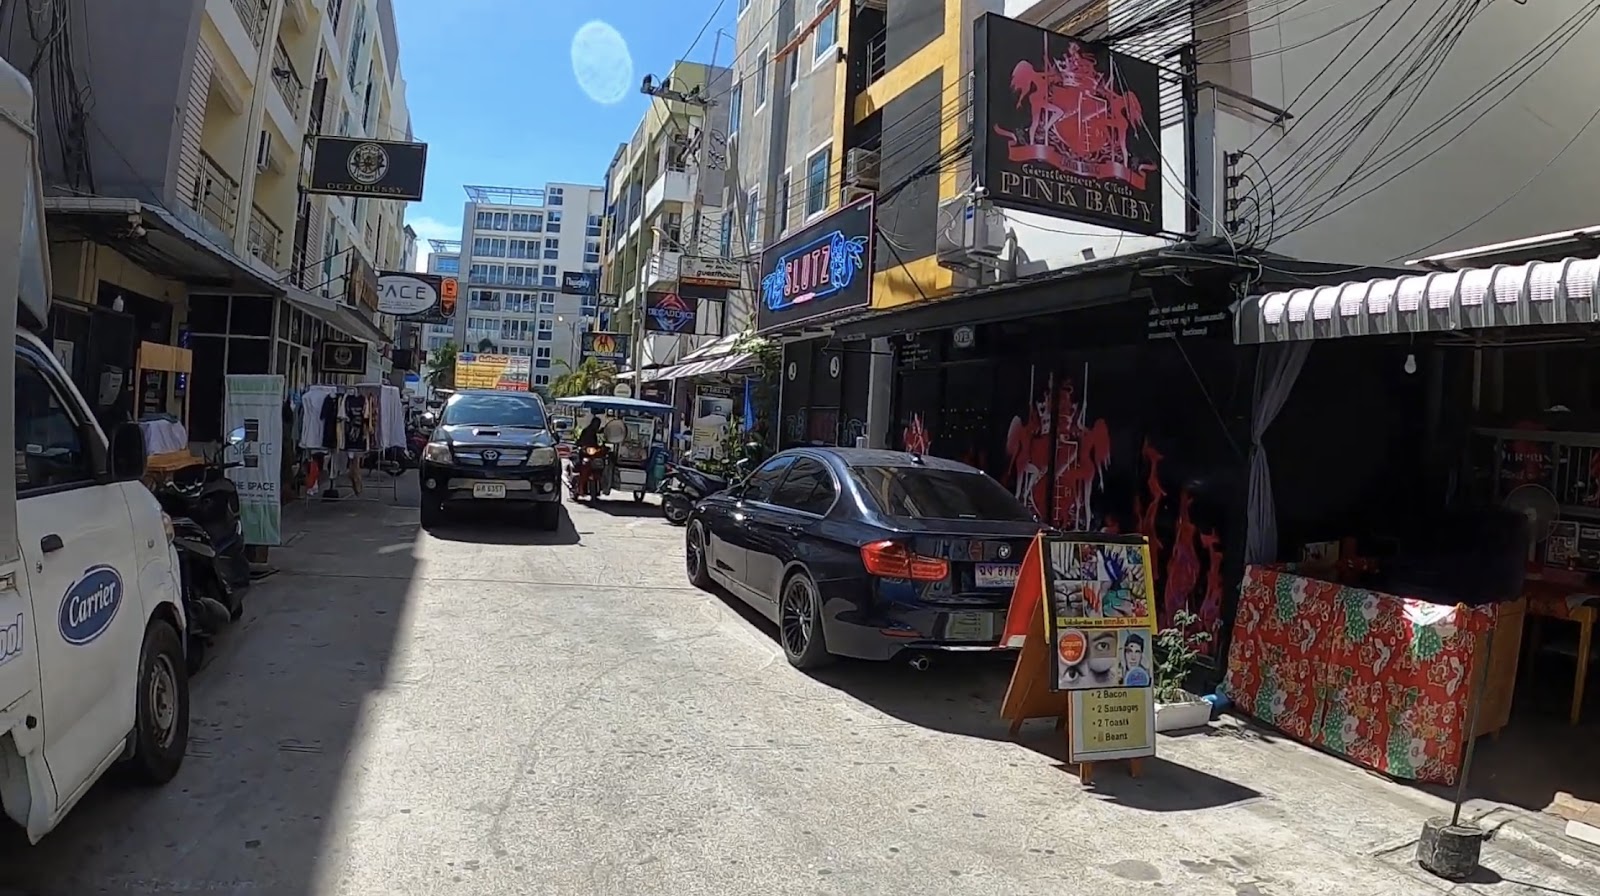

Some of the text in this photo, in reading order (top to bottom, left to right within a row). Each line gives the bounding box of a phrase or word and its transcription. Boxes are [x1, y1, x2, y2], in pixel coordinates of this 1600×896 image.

[1021, 163, 1101, 189] Gentlemen's
[1104, 180, 1133, 197] Club
[326, 182, 404, 194] OCTOPUSSY
[1000, 171, 1154, 223] PINK BABY
[784, 245, 830, 296] SLUTZ
[377, 283, 427, 299] PACE
[247, 482, 275, 491] SPACE
[69, 580, 116, 628] Carrier
[1097, 690, 1127, 699] 2 Bacon
[1097, 704, 1139, 714] 2 Sausages
[1098, 719, 1103, 727] 2
[1105, 732, 1128, 741] Beans
